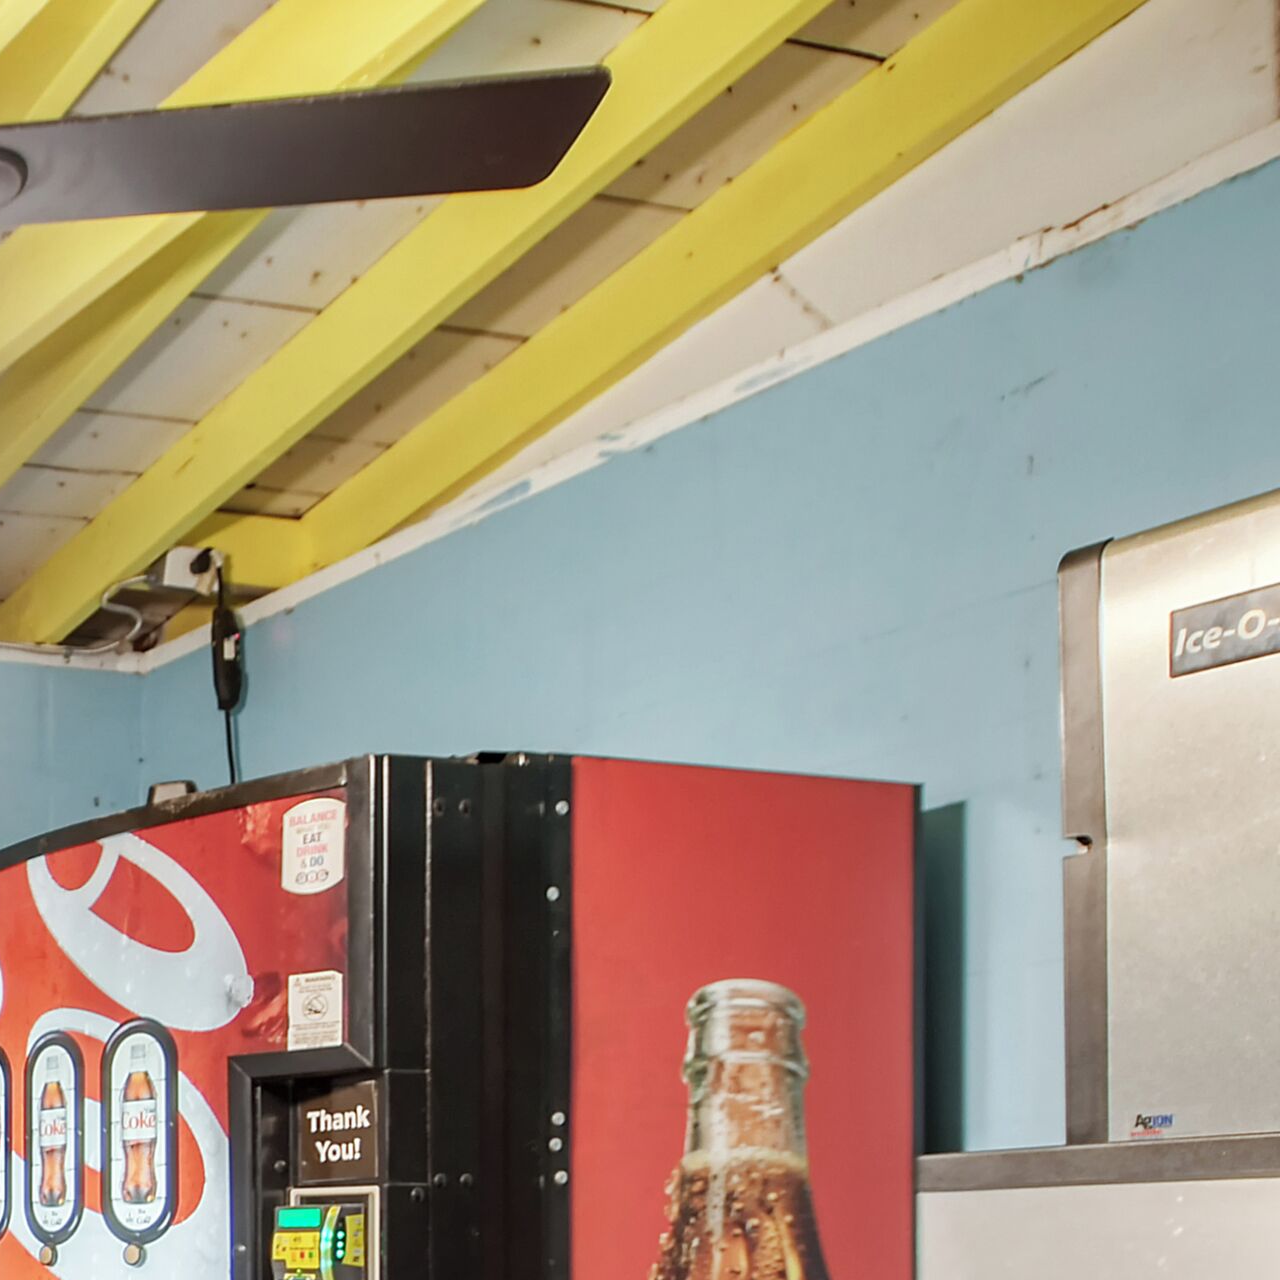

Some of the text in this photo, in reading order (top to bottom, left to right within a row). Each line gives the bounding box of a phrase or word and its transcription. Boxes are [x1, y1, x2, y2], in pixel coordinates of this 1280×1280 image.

[288, 810, 337, 827] BALANCE
[303, 832, 322, 845] EAT
[309, 856, 324, 867] DO
[307, 1105, 370, 1133] Thank
[315, 1138, 361, 1163] You!
